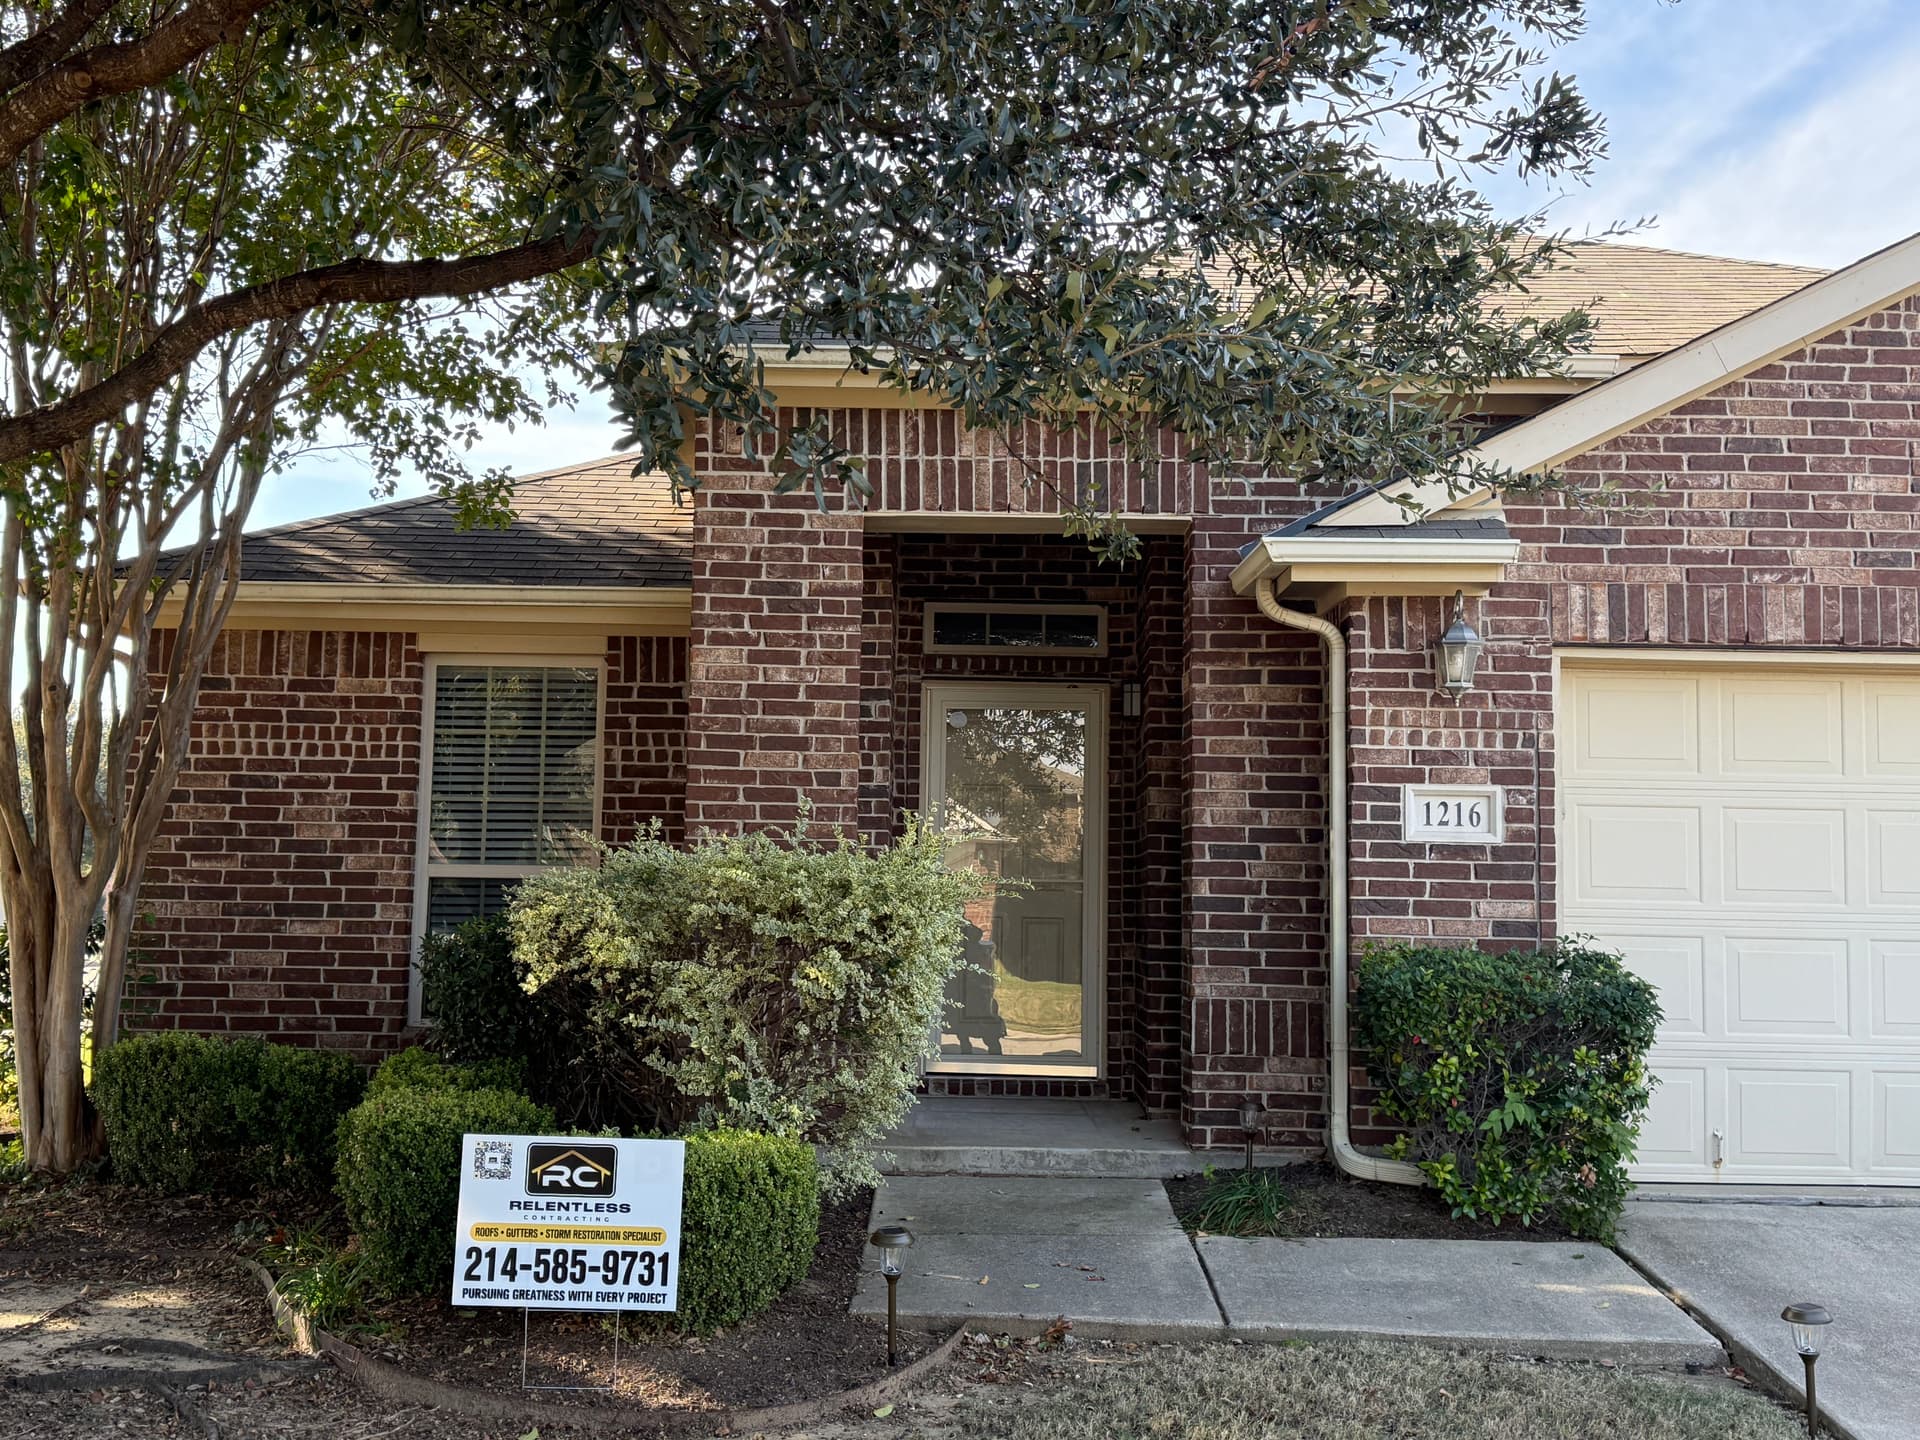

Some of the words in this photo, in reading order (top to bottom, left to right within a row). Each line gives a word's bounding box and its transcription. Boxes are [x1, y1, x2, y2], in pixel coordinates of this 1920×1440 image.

[1424, 801, 1481, 828] 1216
[542, 1165, 600, 1188] RC
[509, 1200, 631, 1213] RELENTLESS
[523, 1214, 610, 1223] CONTRACTING
[475, 1227, 499, 1237] ROOFS
[506, 1228, 538, 1239] GUTTERS
[545, 1229, 571, 1239] STORM
[573, 1229, 621, 1241] RESTORATION
[623, 1231, 662, 1242] SPECIALIST
[464, 1246, 670, 1287] 214-585-9731
[462, 1288, 510, 1300] PURSUING
[512, 1289, 565, 1301] GREATNESS
[568, 1290, 592, 1302] WITH
[595, 1291, 624, 1303] EVERY
[627, 1292, 667, 1305] PROJECT
